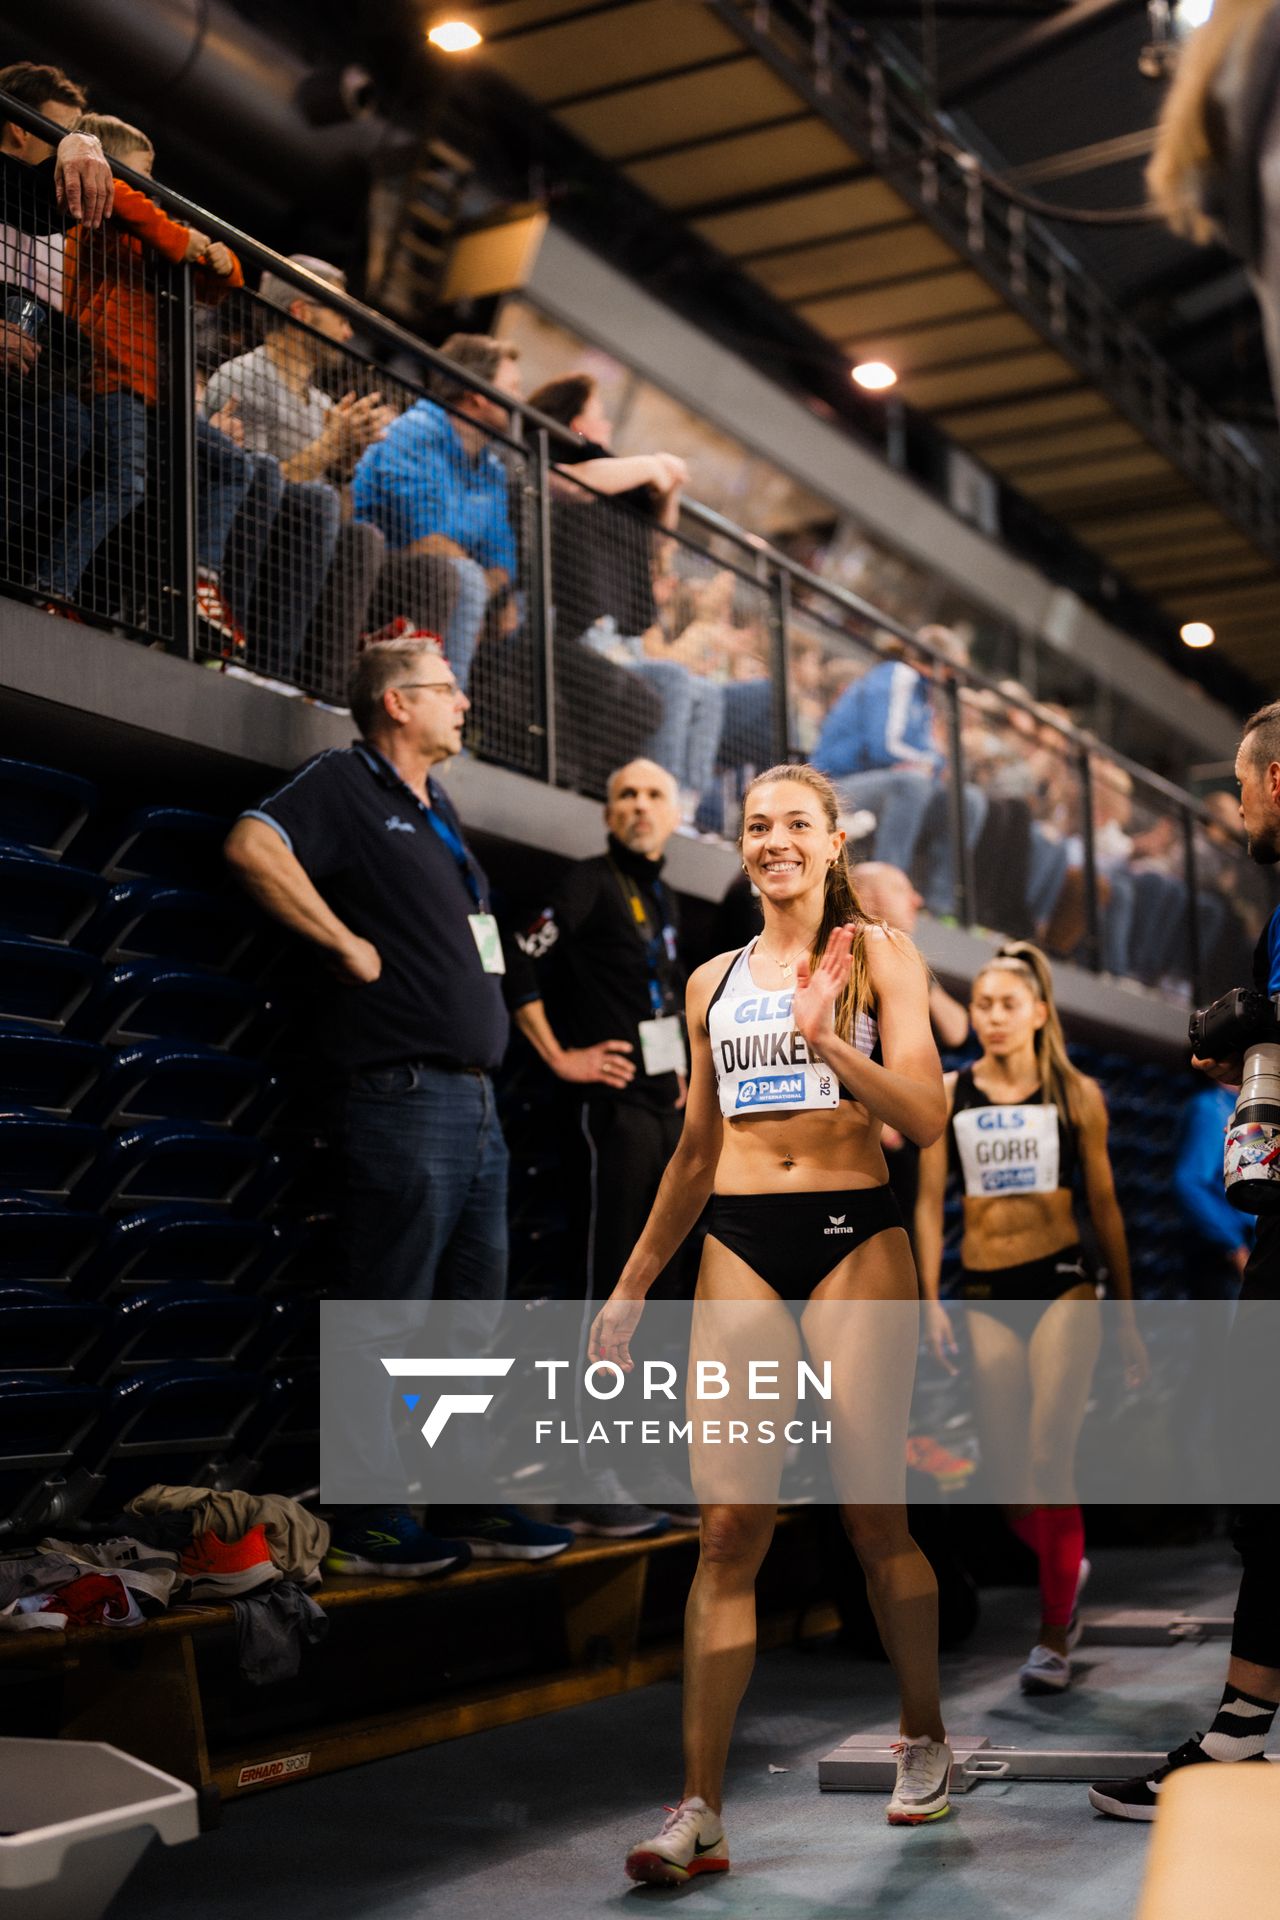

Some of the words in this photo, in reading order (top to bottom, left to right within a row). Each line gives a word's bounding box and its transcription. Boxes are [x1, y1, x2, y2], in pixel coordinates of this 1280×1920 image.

[734, 993, 796, 1024] GLS
[759, 1079, 802, 1095] PLAN
[819, 1076, 831, 1096] 292
[977, 1110, 1025, 1131] GLS
[975, 1138, 1038, 1165] GORR
[823, 1226, 854, 1235] erima
[241, 1762, 284, 1783] ERHARD
[285, 1755, 309, 1772] SPORT
